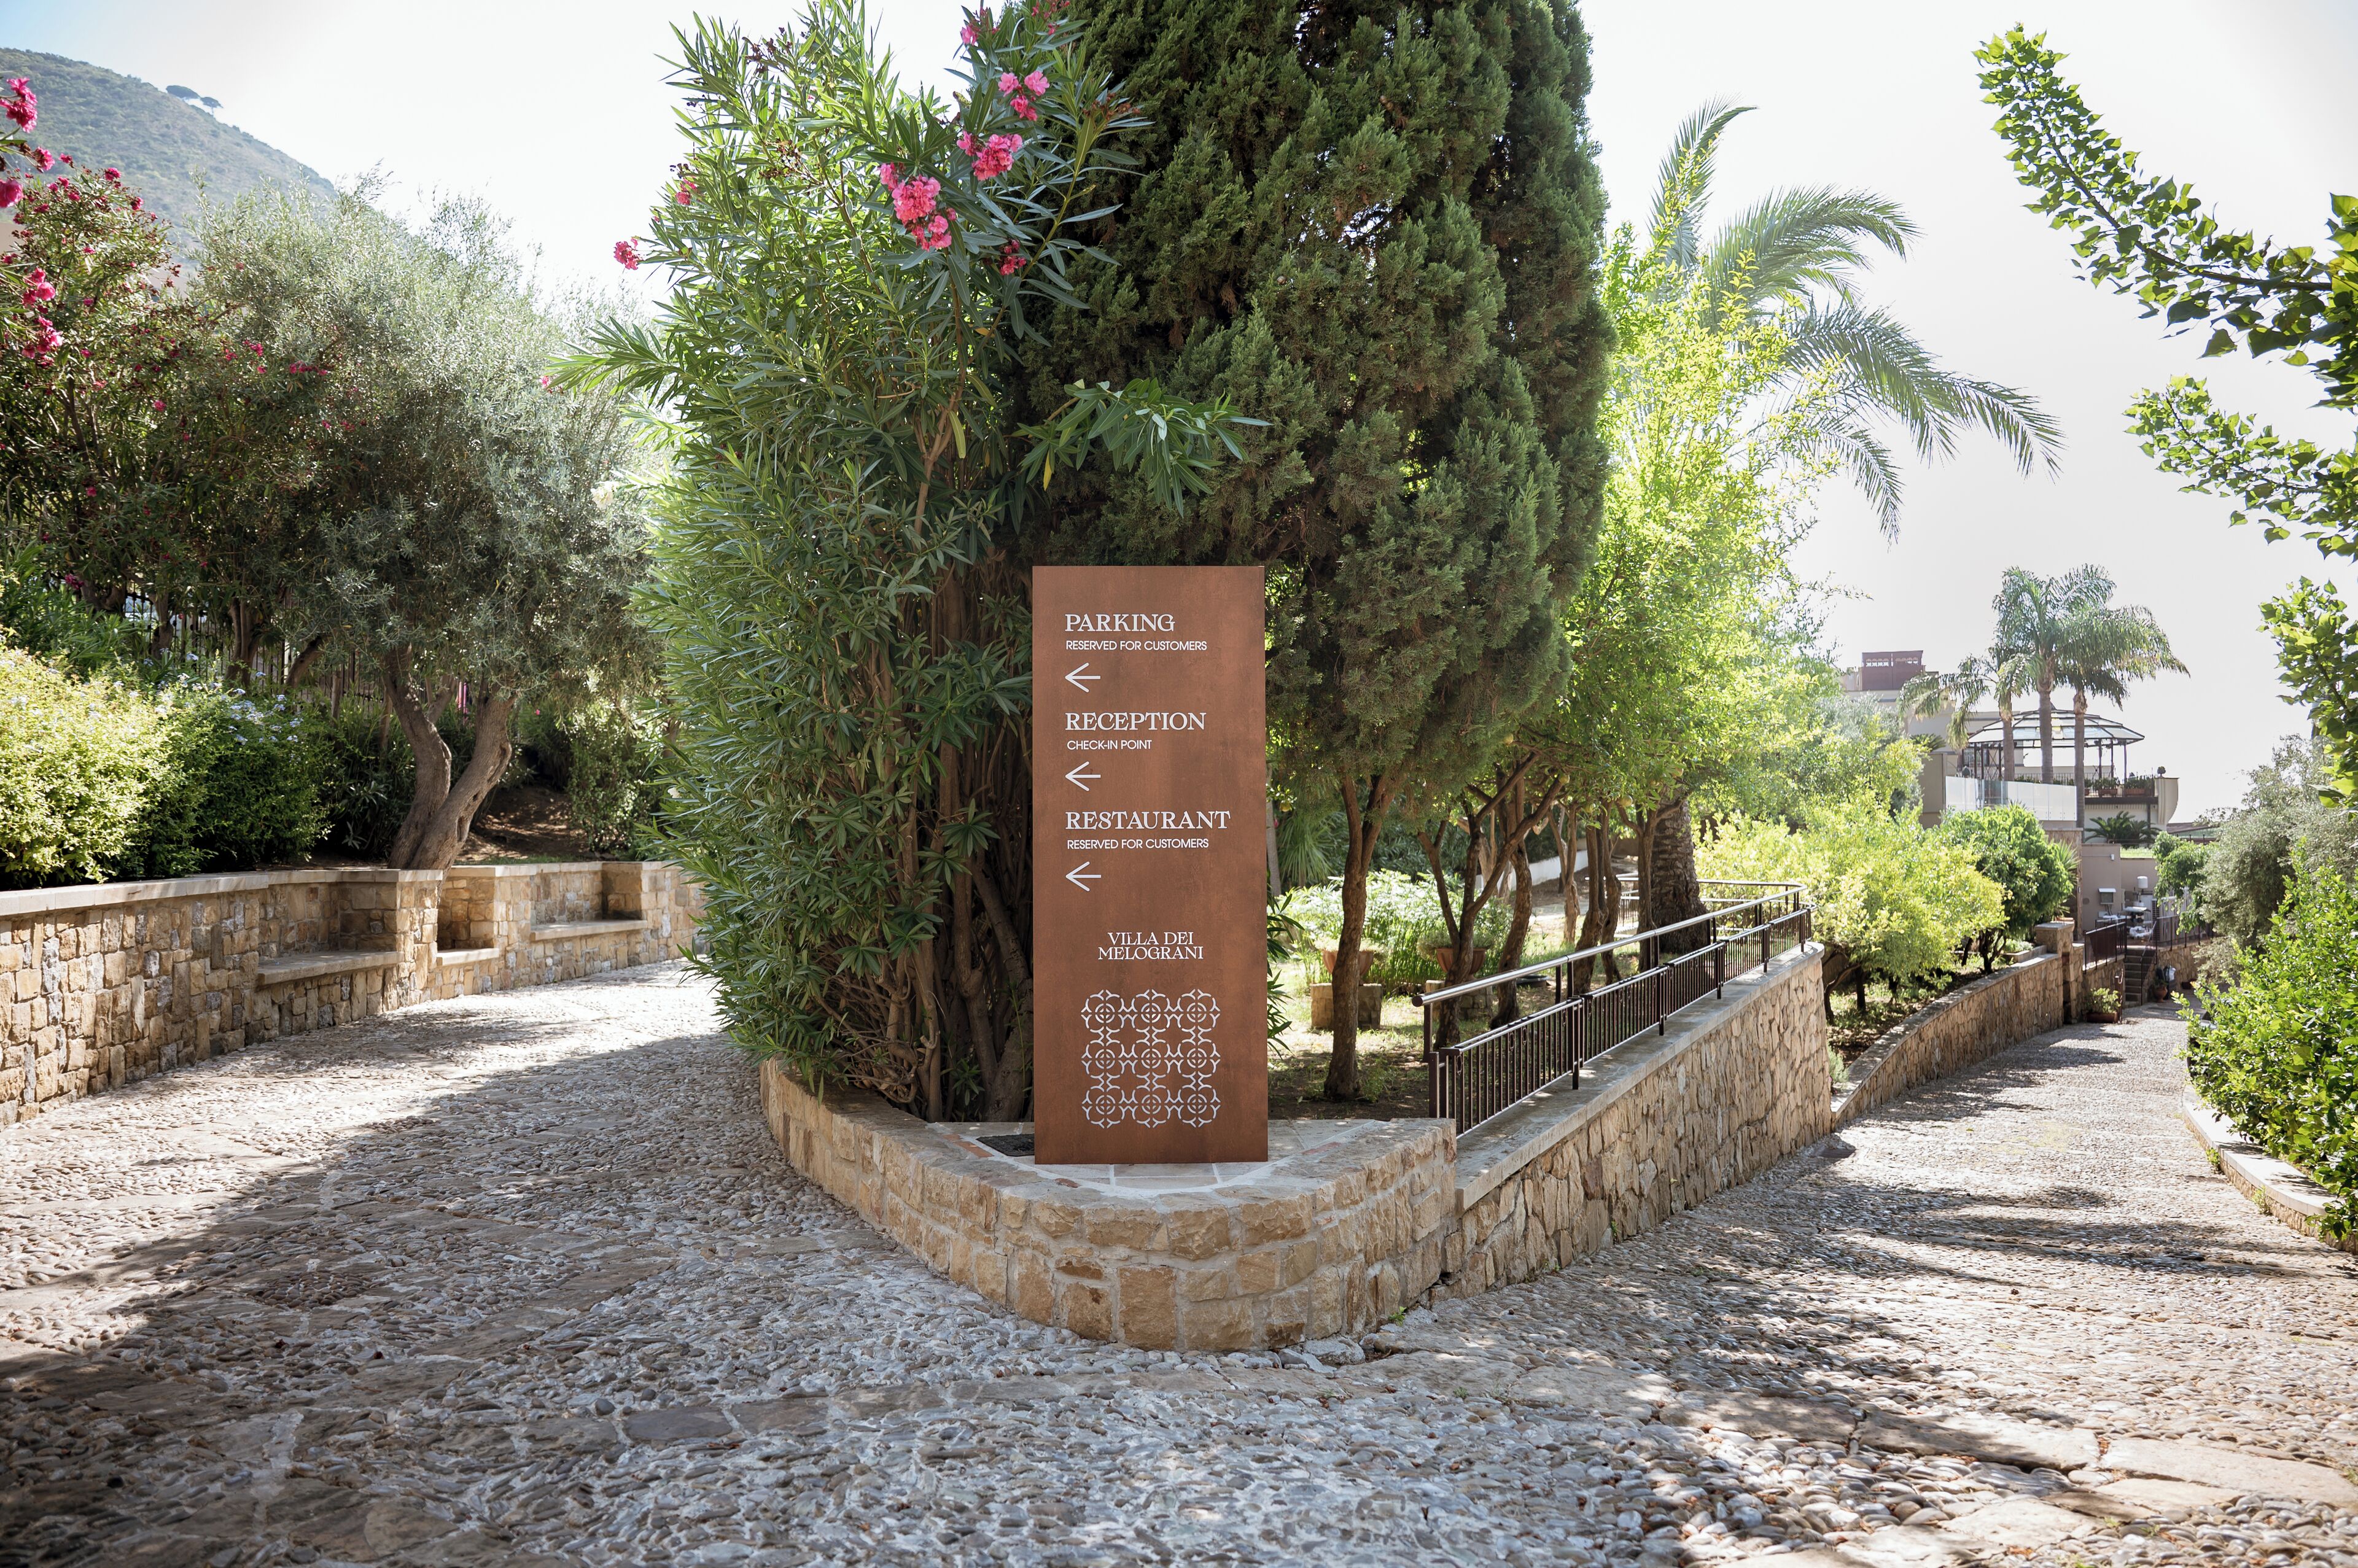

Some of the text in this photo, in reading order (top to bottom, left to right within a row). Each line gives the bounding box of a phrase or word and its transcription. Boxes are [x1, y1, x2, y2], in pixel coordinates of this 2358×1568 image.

[1065, 614, 1175, 632] PARKING
[1066, 640, 1207, 651] RESERVED FOR CUSTOMERS
[1065, 712, 1207, 731] RECEPTION
[1067, 740, 1152, 750] CHECK-IN POINT
[1065, 810, 1231, 830] RESTAURANT
[1067, 839, 1209, 850] RESERVED FOR CUSTOMERS
[1108, 931, 1194, 946] VILLA DEI
[1098, 946, 1204, 961] MELOGRANI
